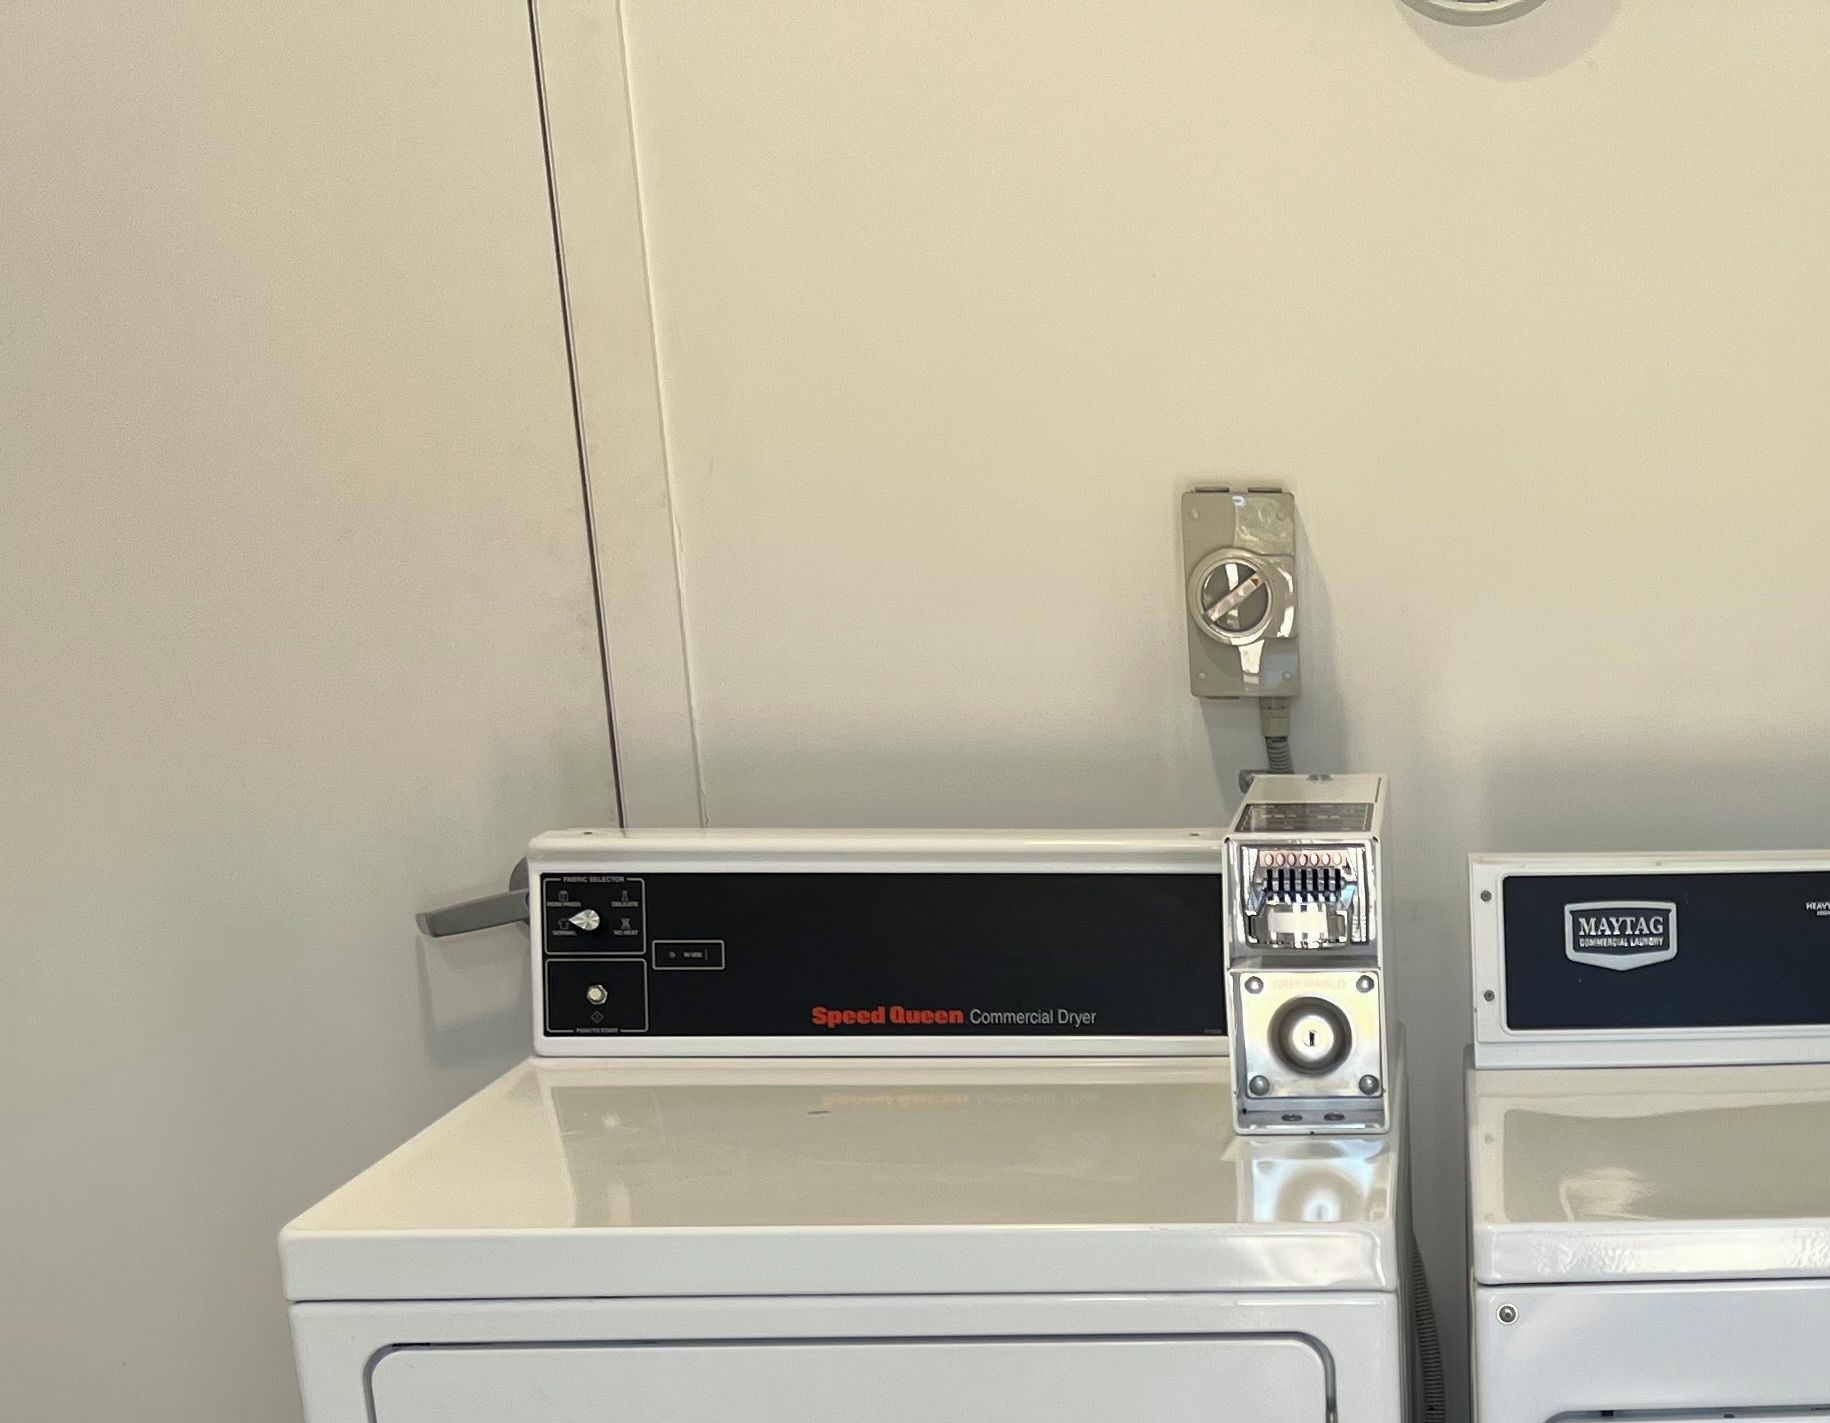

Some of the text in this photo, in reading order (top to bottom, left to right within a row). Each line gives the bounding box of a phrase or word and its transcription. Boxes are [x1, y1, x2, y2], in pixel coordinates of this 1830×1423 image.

[1578, 916, 1664, 936] MAYTAG
[1579, 936, 1664, 947] COMMERCIAL LAUNDRY
[811, 1006, 1097, 1028] Speed Queen Commercial Dryer
